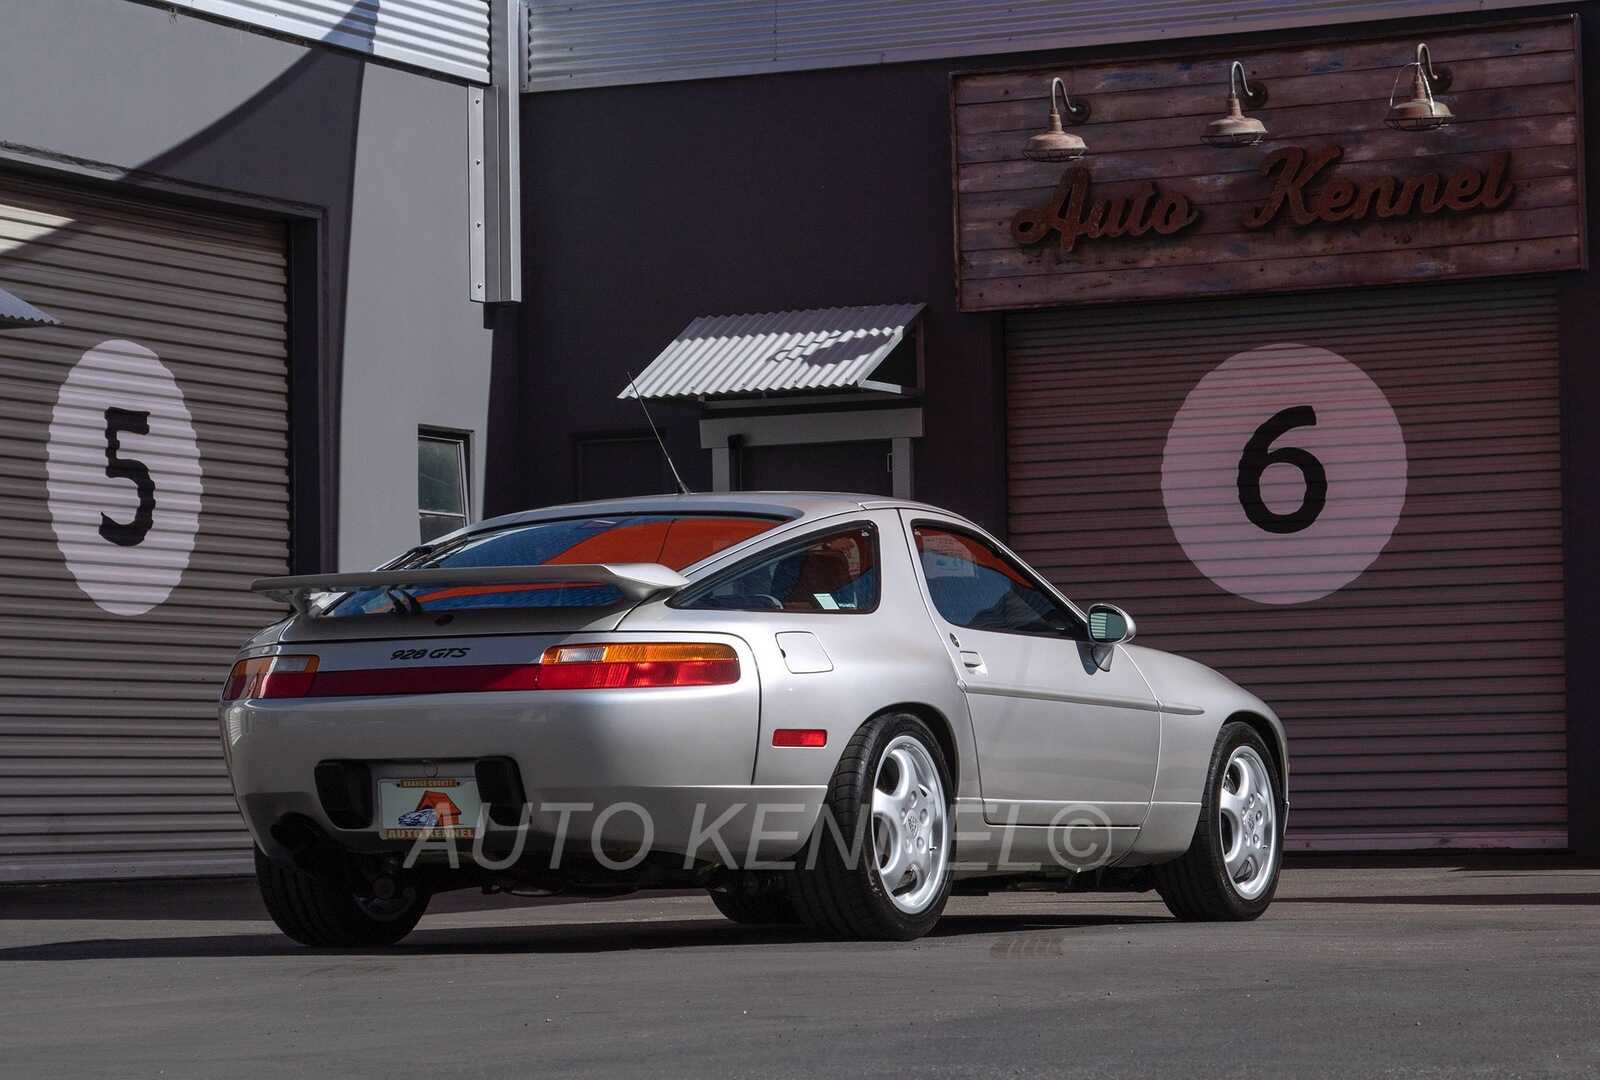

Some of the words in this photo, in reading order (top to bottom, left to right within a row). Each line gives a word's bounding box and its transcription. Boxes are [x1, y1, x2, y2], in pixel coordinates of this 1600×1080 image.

[1014, 166, 1199, 253] Auto
[1246, 145, 1514, 227] Kennel
[99, 406, 156, 546] 5
[1237, 405, 1328, 534] 6
[390, 648, 428, 660] 928
[430, 647, 471, 659] GTS
